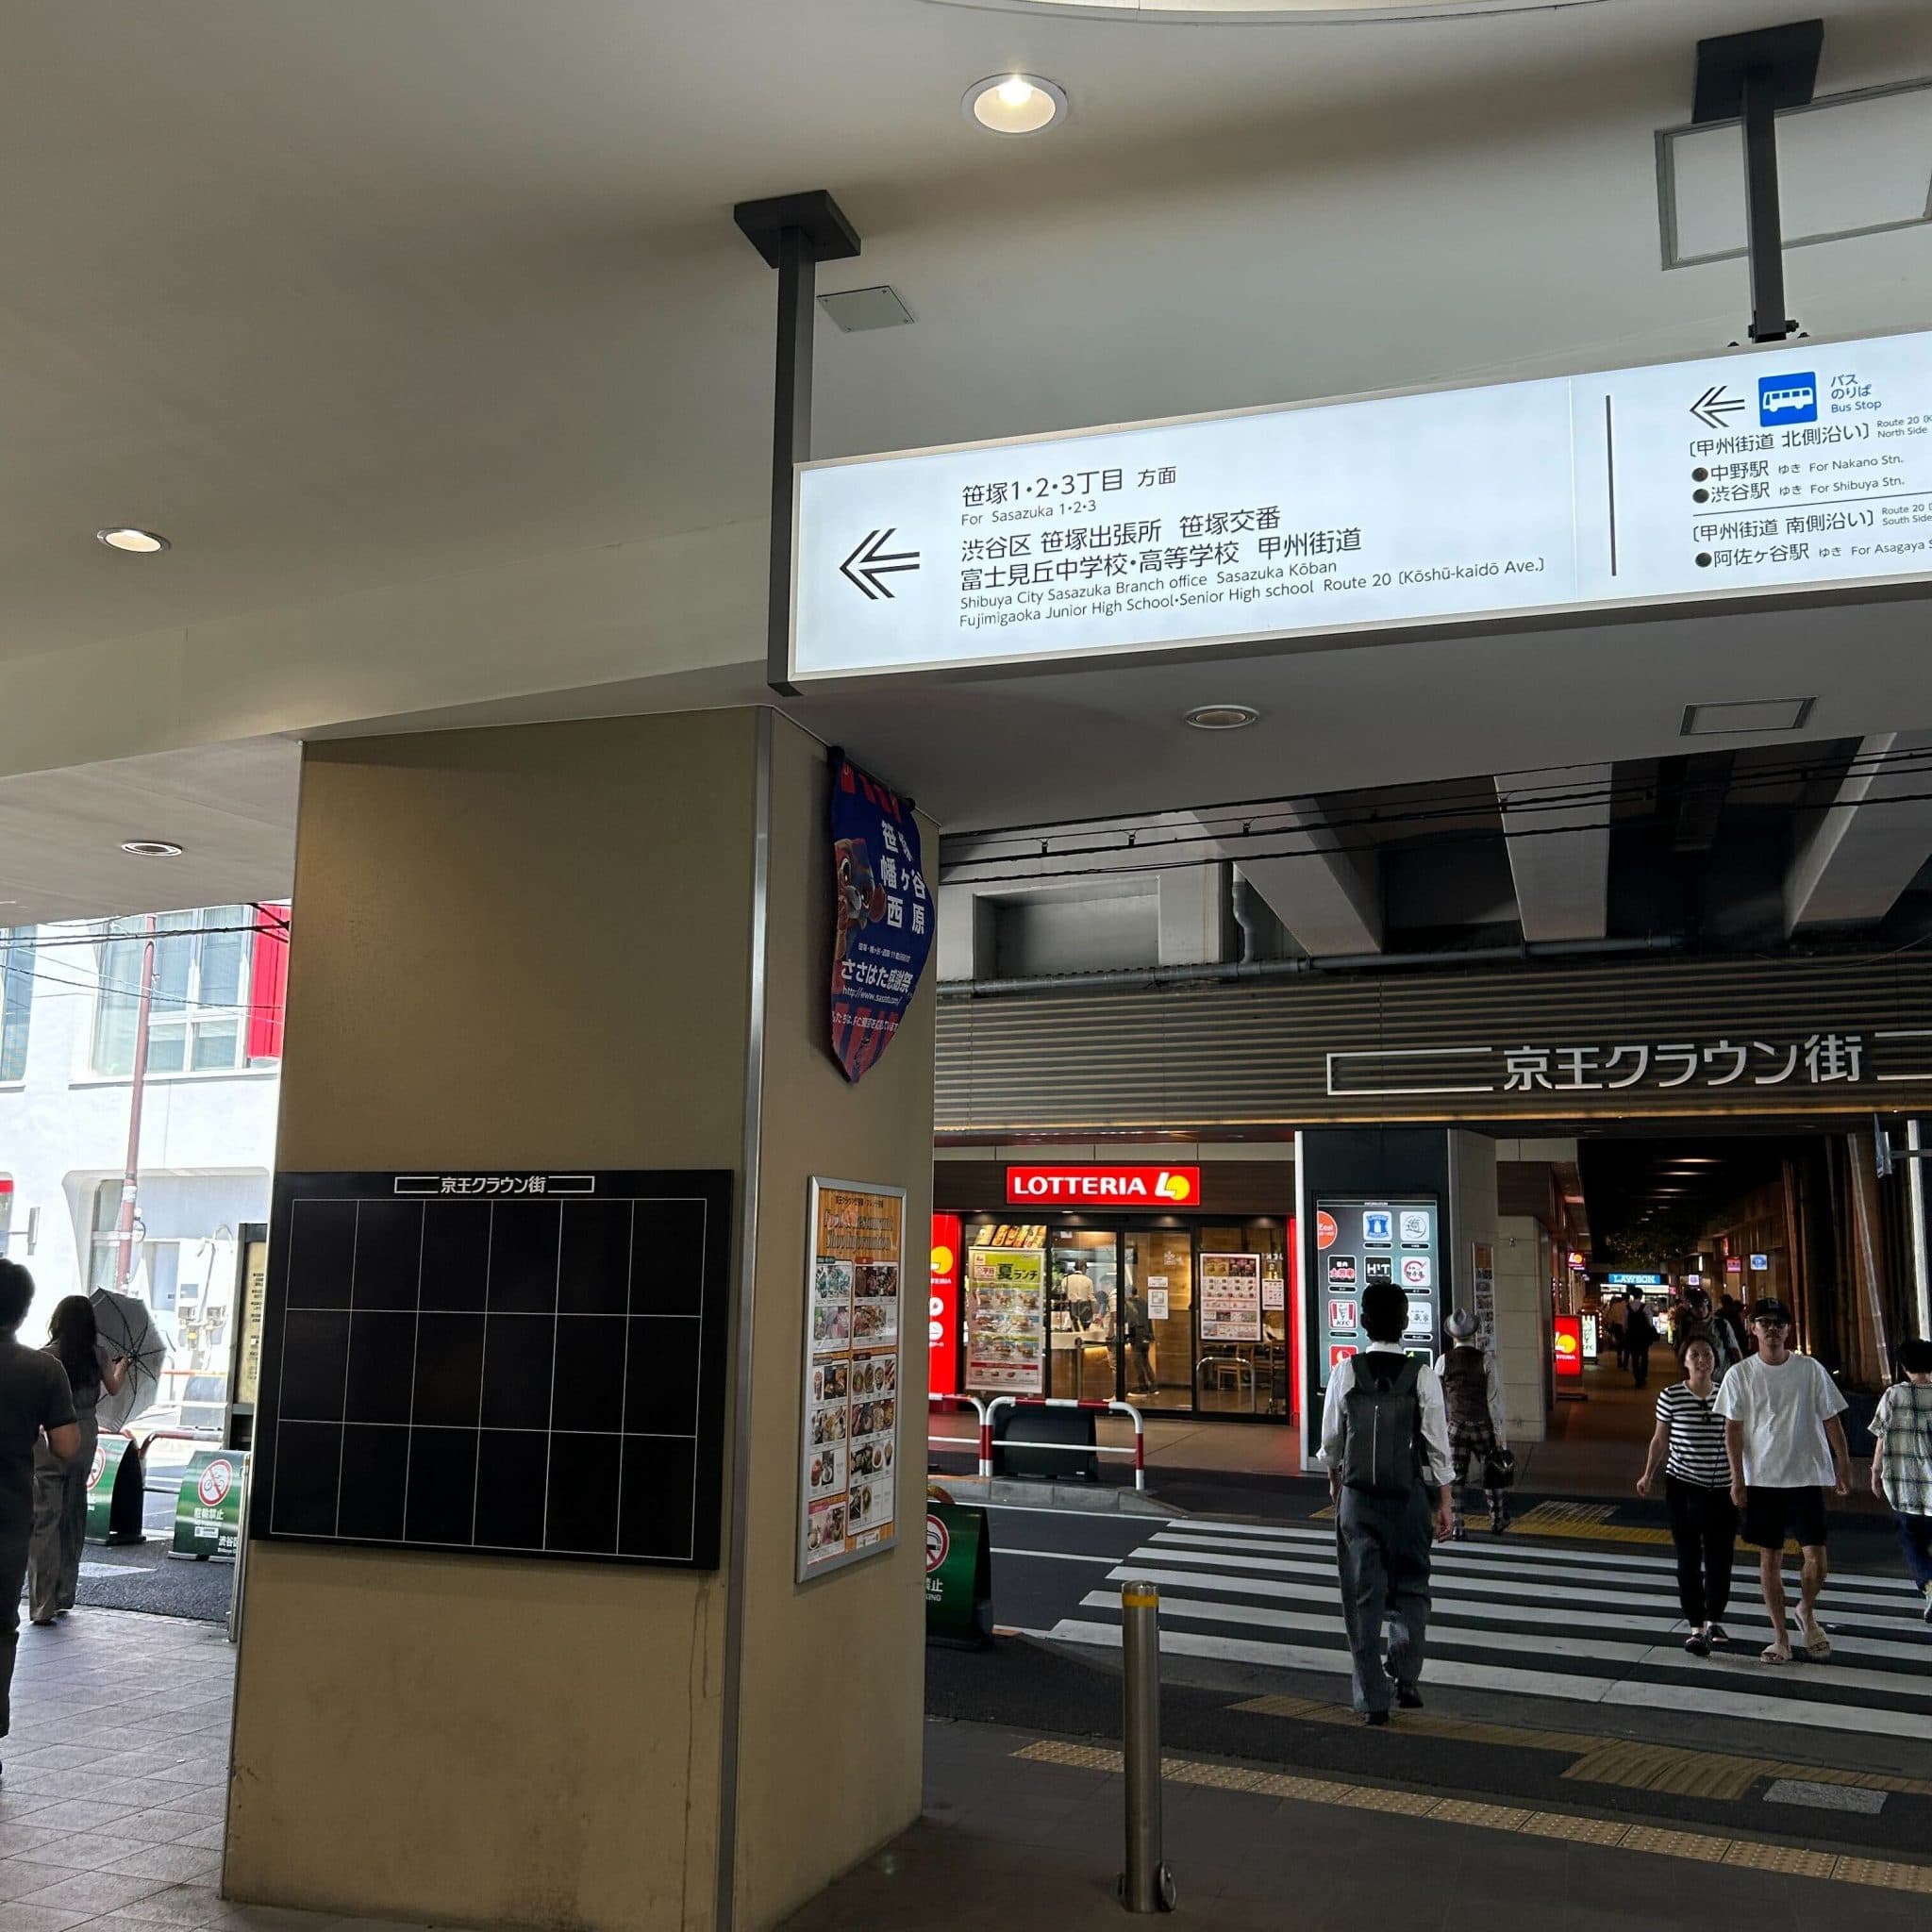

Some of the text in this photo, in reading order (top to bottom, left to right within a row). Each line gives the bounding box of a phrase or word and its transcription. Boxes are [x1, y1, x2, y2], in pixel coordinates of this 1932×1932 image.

[1831, 374, 1858, 387] バス
[1831, 384, 1872, 400] のりば
[1831, 399, 1882, 413] Bus Stop
[1876, 419, 1905, 427] Route
[1907, 415, 1920, 425] 20
[1877, 425, 1928, 438] North Side
[1138, 465, 1177, 488] 方面
[1710, 454, 1905, 482] 中野駅 ゆき For Nakano Stn.
[1710, 475, 1906, 503] 渋谷駅 ゆき For Shibuya Stn.
[961, 513, 984, 525] For
[991, 505, 1054, 523] Sasazuka
[1881, 506, 1909, 515] Route
[1912, 504, 1924, 512] 20
[1882, 515, 1910, 525] South
[961, 505, 1282, 562] 渋谷区 笹塚出張所 笹塚交番
[1258, 526, 1362, 560] 甲州街道
[1818, 546, 1842, 558] ゆき
[1851, 546, 1871, 556] For
[1874, 541, 1925, 555] Asagaya
[960, 560, 1337, 611] Shibuya City Sasazuka Branch office Sasazuka Kōban
[959, 608, 1041, 629] Fujimigaoka
[1045, 604, 1087, 619] Junior
[1091, 599, 1123, 616] High
[1228, 586, 1260, 603] High
[1265, 580, 1314, 598] school
[1324, 576, 1367, 591] Route
[1373, 573, 1392, 587] 20
[887, 894, 925, 935] 西原
[1504, 1033, 1862, 1091] 京王クラウン街
[441, 1175, 546, 1193] 京王クラウン街
[1014, 1176, 1146, 1196] LOTTERIA
[997, 1263, 1039, 1281] 夏ランチ
[1613, 1274, 1657, 1283] LAWSON
